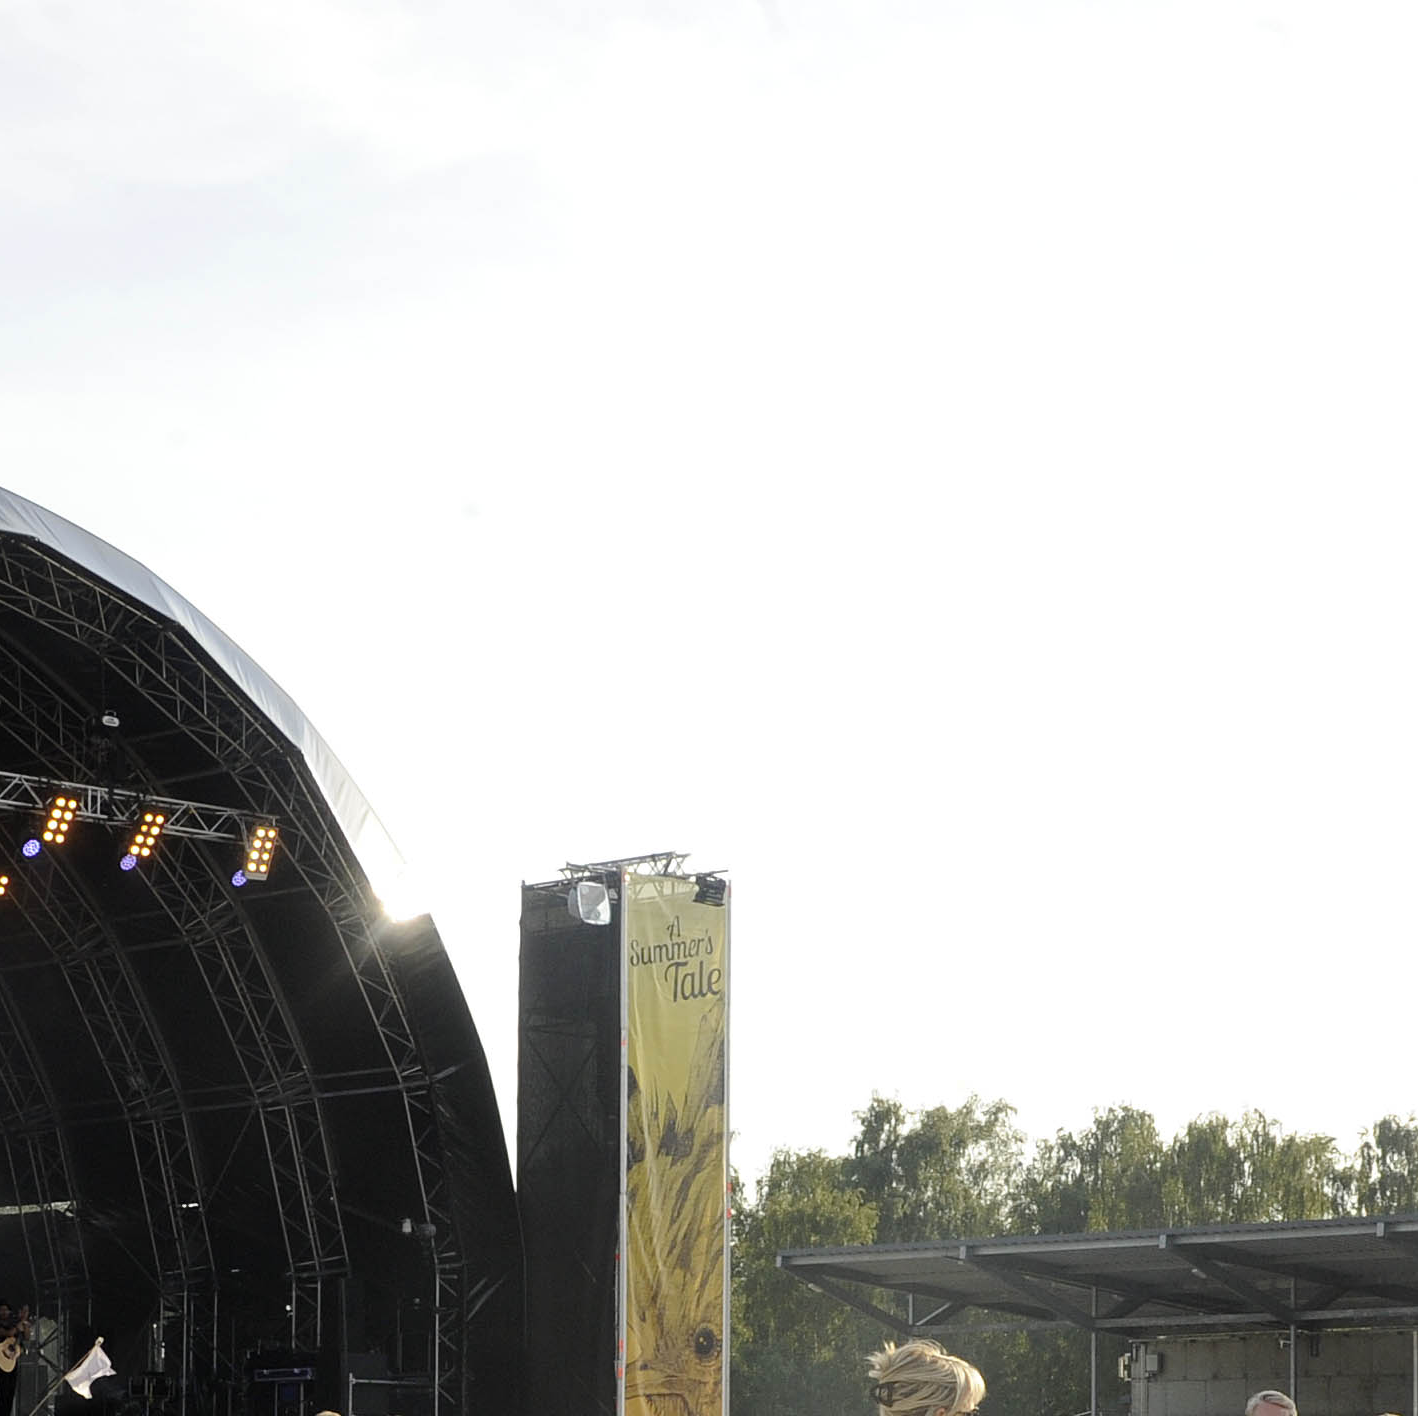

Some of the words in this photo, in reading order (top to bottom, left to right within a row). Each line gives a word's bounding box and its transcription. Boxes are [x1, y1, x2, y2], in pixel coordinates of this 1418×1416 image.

[630, 928, 713, 967] Summer's
[666, 915, 681, 941] A
[664, 960, 722, 1003] Tale
